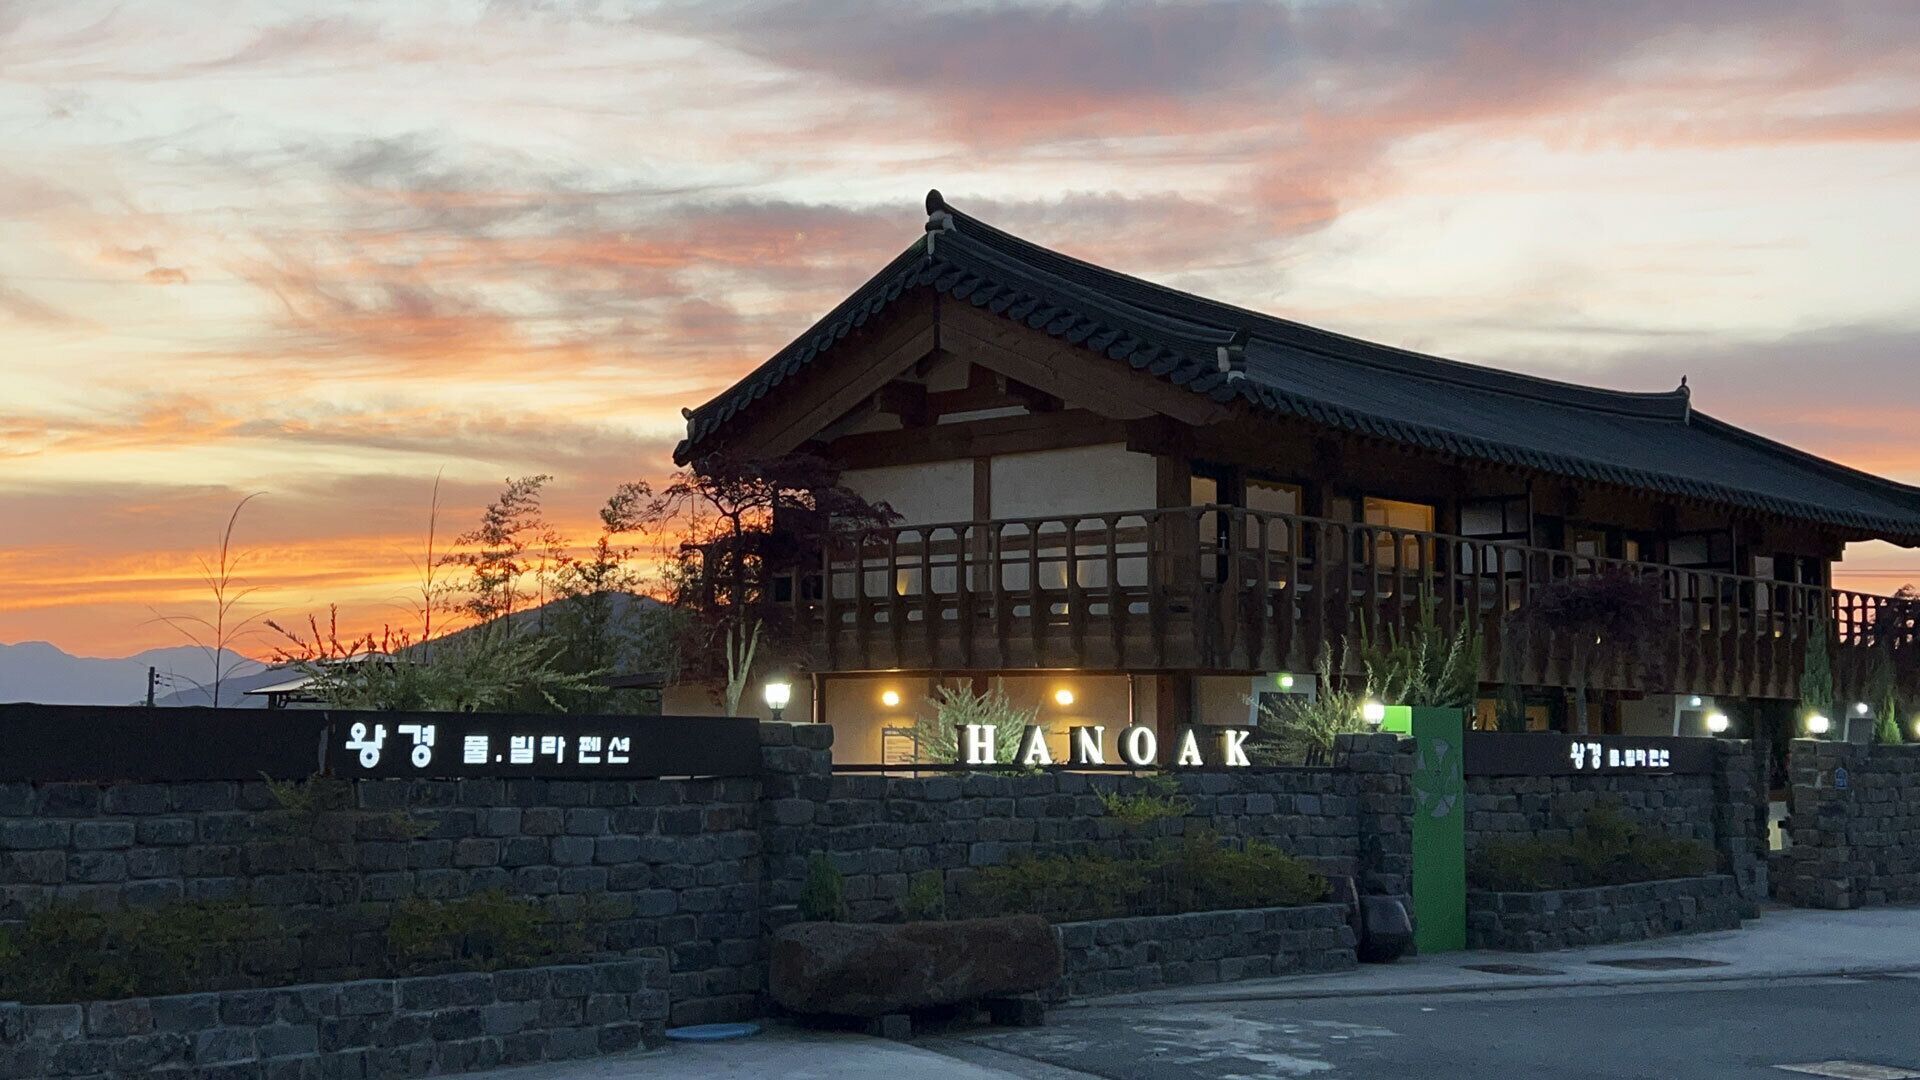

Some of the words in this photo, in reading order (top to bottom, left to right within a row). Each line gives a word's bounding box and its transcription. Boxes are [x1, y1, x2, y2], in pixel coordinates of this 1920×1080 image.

[346, 722, 435, 768] 왕경
[464, 735, 566, 764] 풀.빌라
[578, 736, 630, 763] 펜션
[964, 723, 1251, 766] HANOAK
